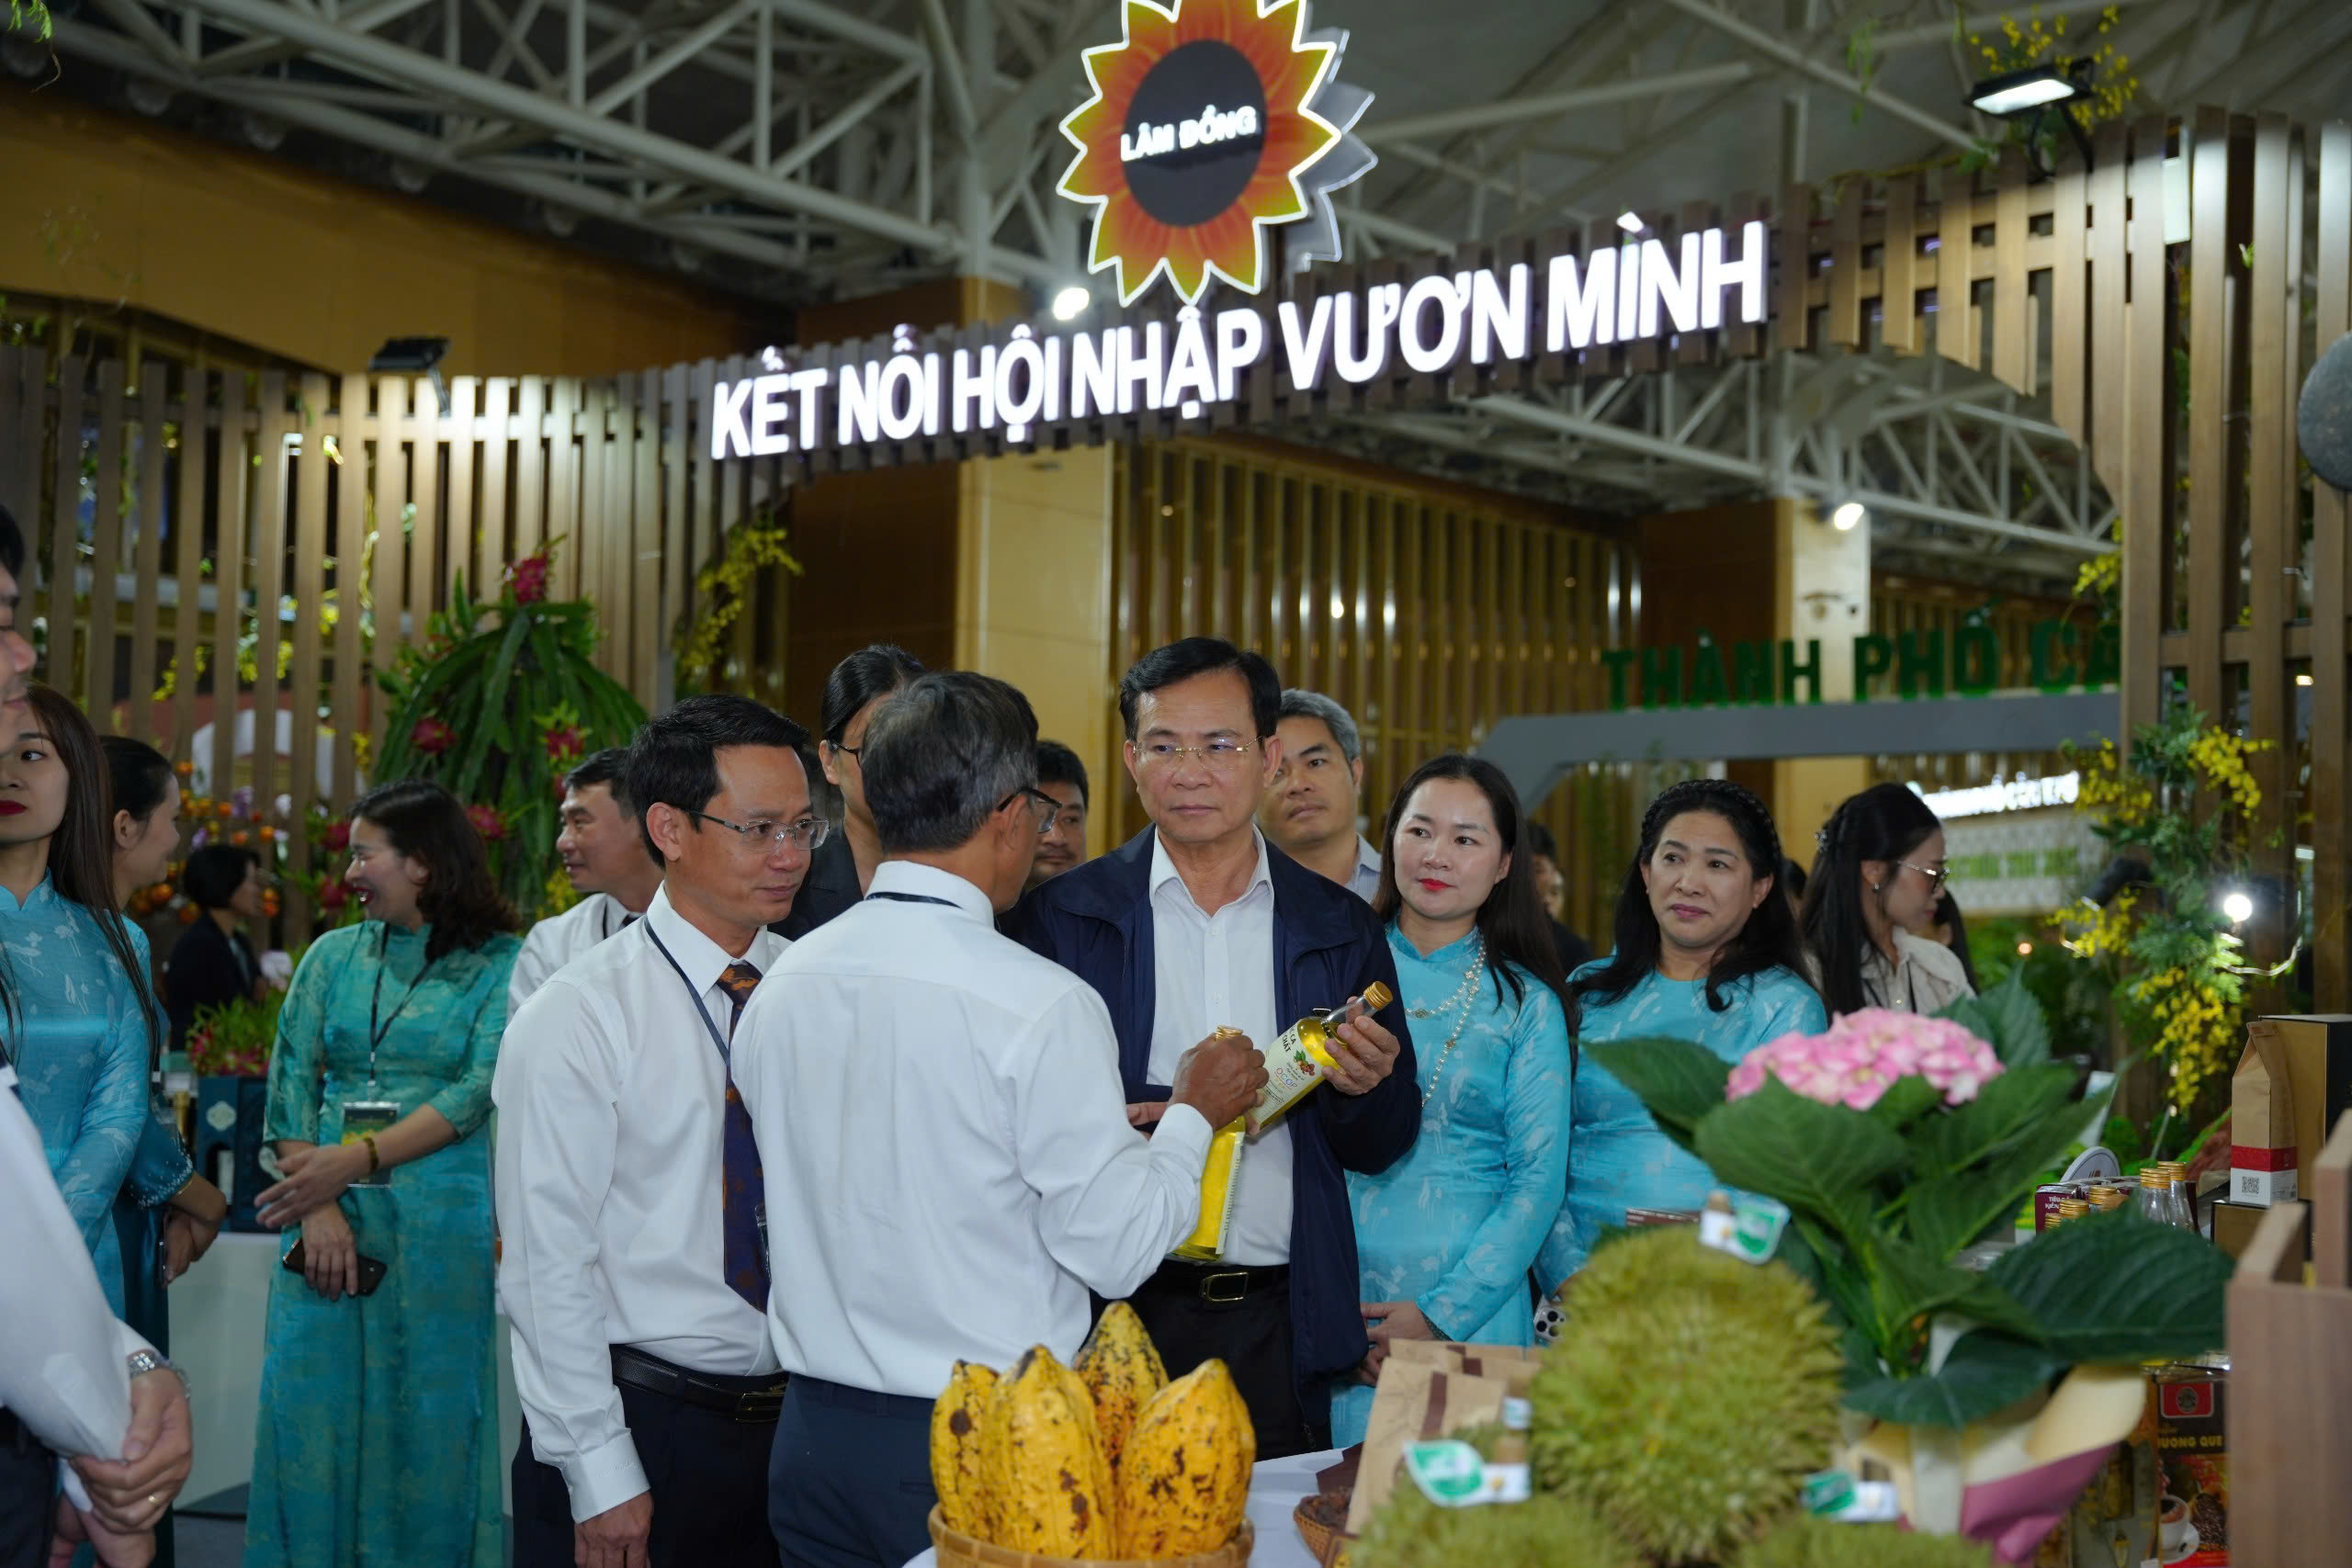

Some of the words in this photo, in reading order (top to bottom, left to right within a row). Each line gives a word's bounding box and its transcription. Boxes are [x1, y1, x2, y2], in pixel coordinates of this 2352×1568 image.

[711, 345, 828, 459] KẾT
[838, 323, 941, 446] NỐI
[953, 324, 1061, 443] HỘI
[1070, 304, 1264, 420] NHẬP
[1278, 263, 1530, 389] VƯƠN
[1546, 210, 1766, 353] MÌNH
[1601, 628, 1822, 712] THÀNH
[1854, 597, 1999, 702] PHỐ
